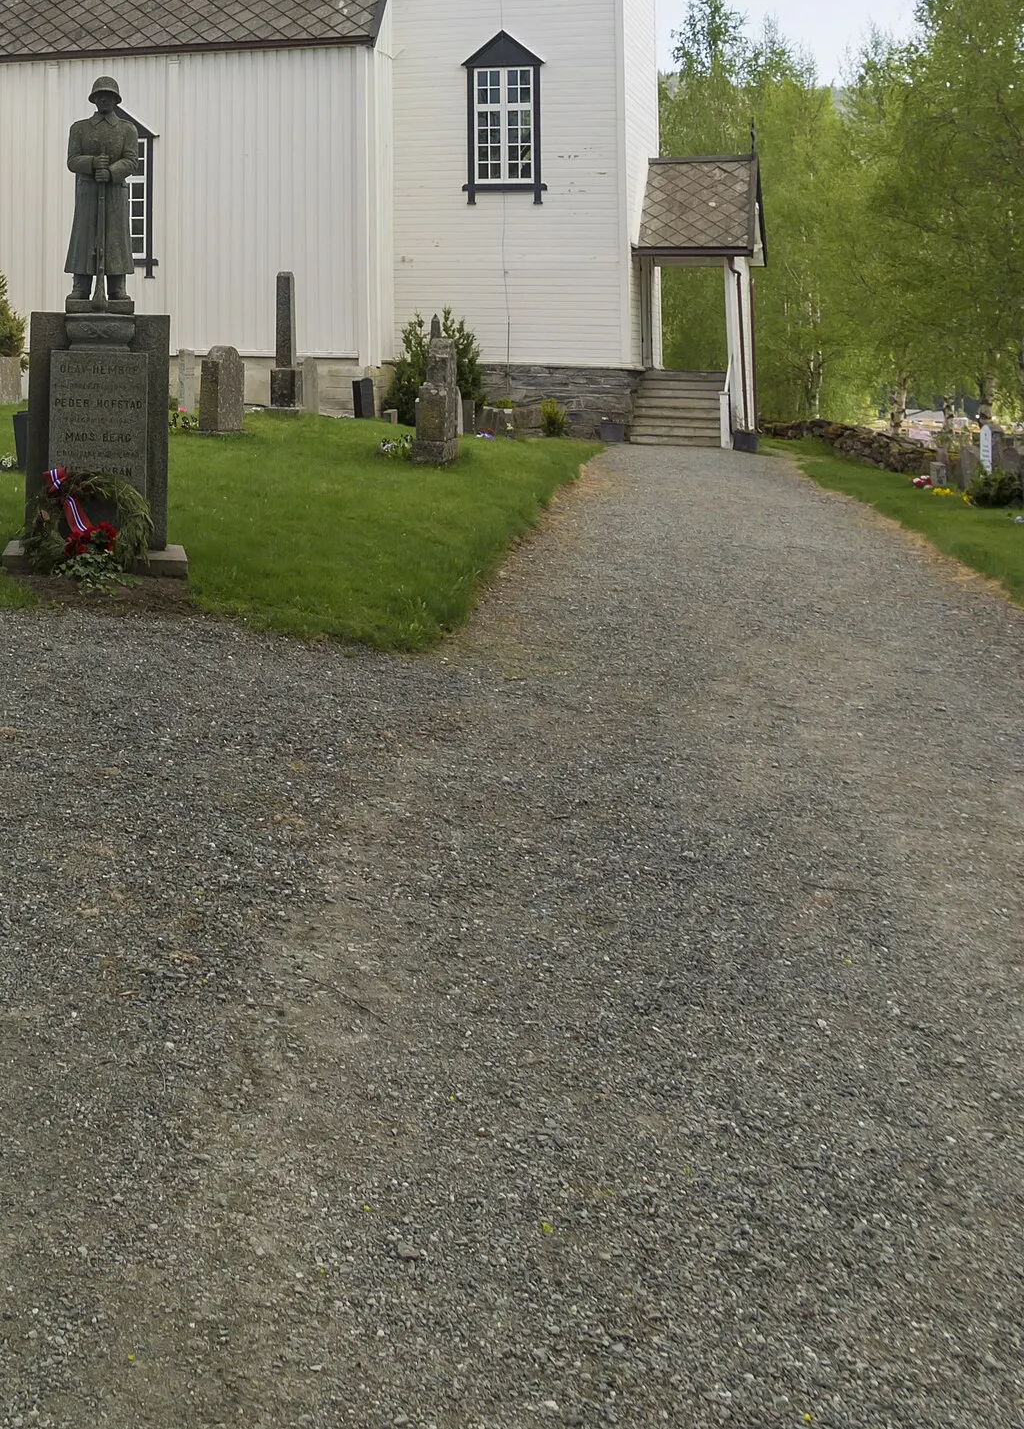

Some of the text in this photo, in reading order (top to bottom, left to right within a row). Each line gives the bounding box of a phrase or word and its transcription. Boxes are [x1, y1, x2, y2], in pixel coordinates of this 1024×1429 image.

[54, 398, 143, 410] PEDER HOFSTAD
[65, 432, 132, 443] MADS BERG
